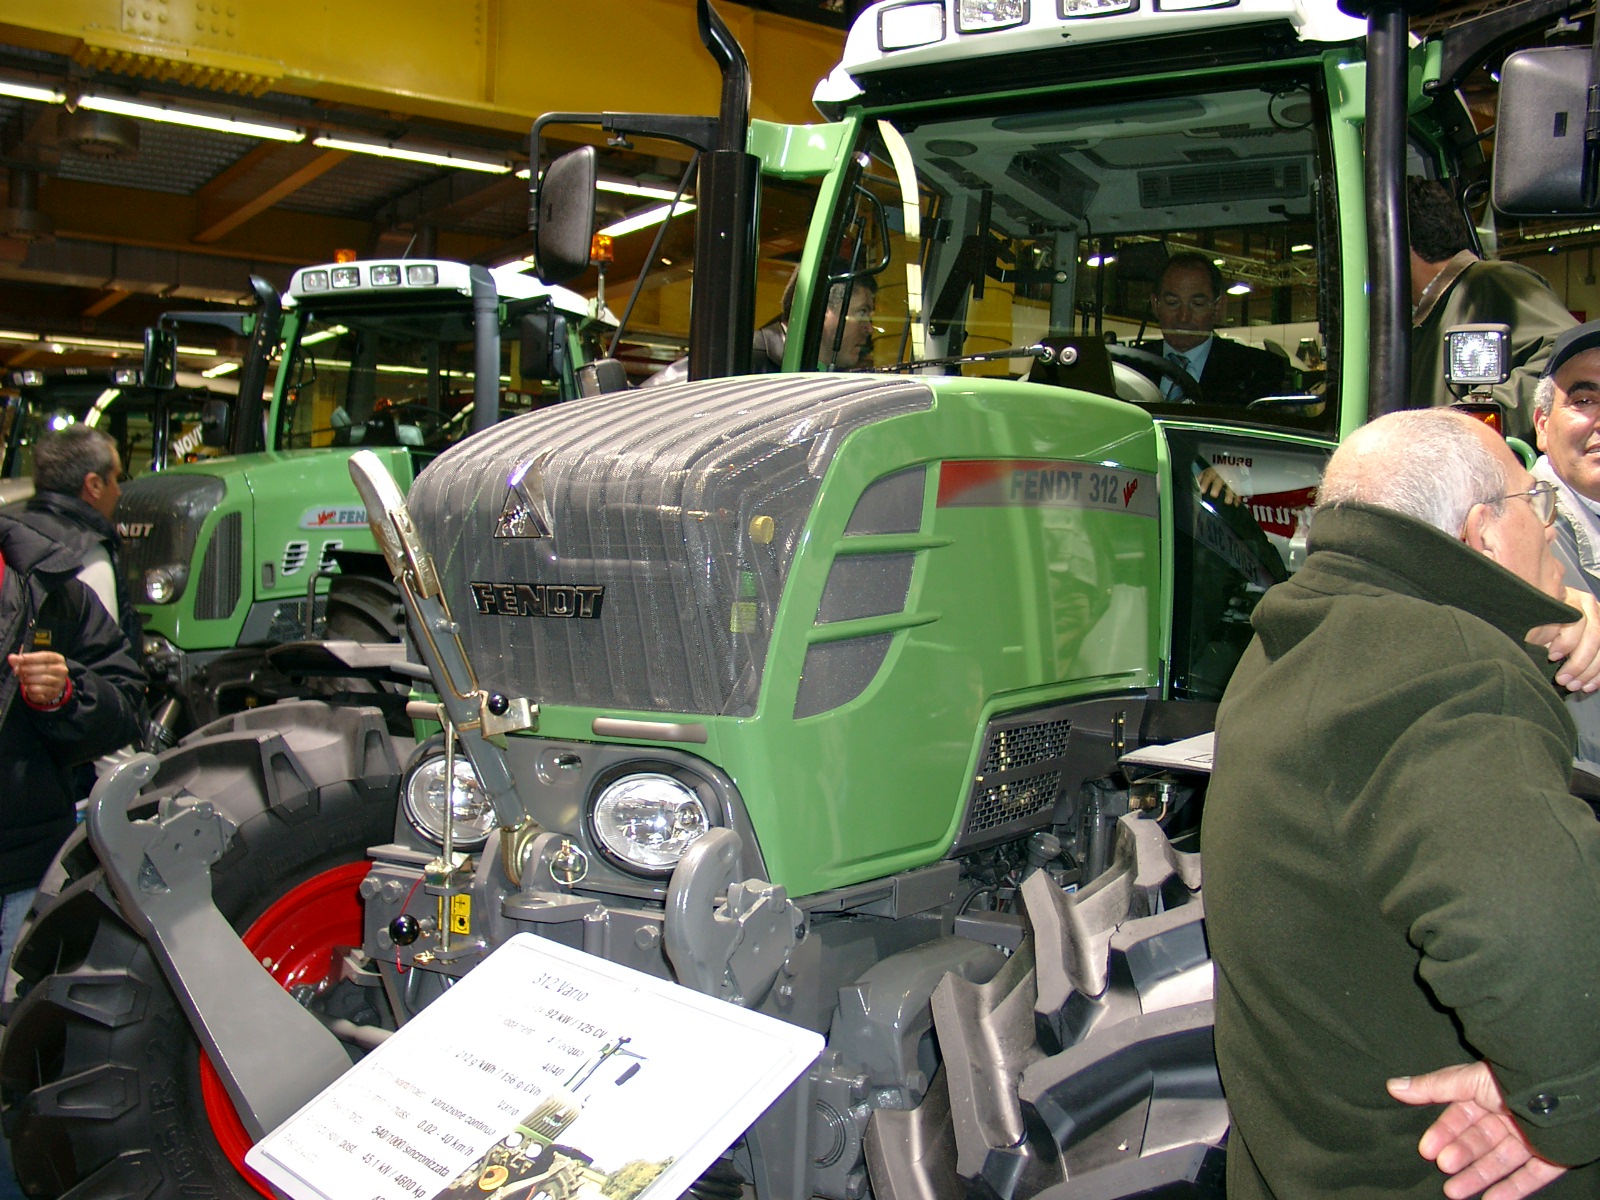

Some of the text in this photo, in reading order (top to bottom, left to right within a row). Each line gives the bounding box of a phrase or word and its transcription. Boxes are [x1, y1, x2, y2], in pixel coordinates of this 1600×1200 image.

[1010, 469, 1083, 500] FENDT
[1089, 472, 1118, 504] 312
[338, 509, 368, 523] FEN
[117, 522, 154, 537] NDT
[470, 582, 603, 618] FENDT
[532, 972, 589, 1002] 312 Vario
[556, 1013, 574, 1025] kW
[577, 1022, 595, 1034] 125
[592, 1028, 608, 1039] CV
[394, 1174, 417, 1191] 4600
